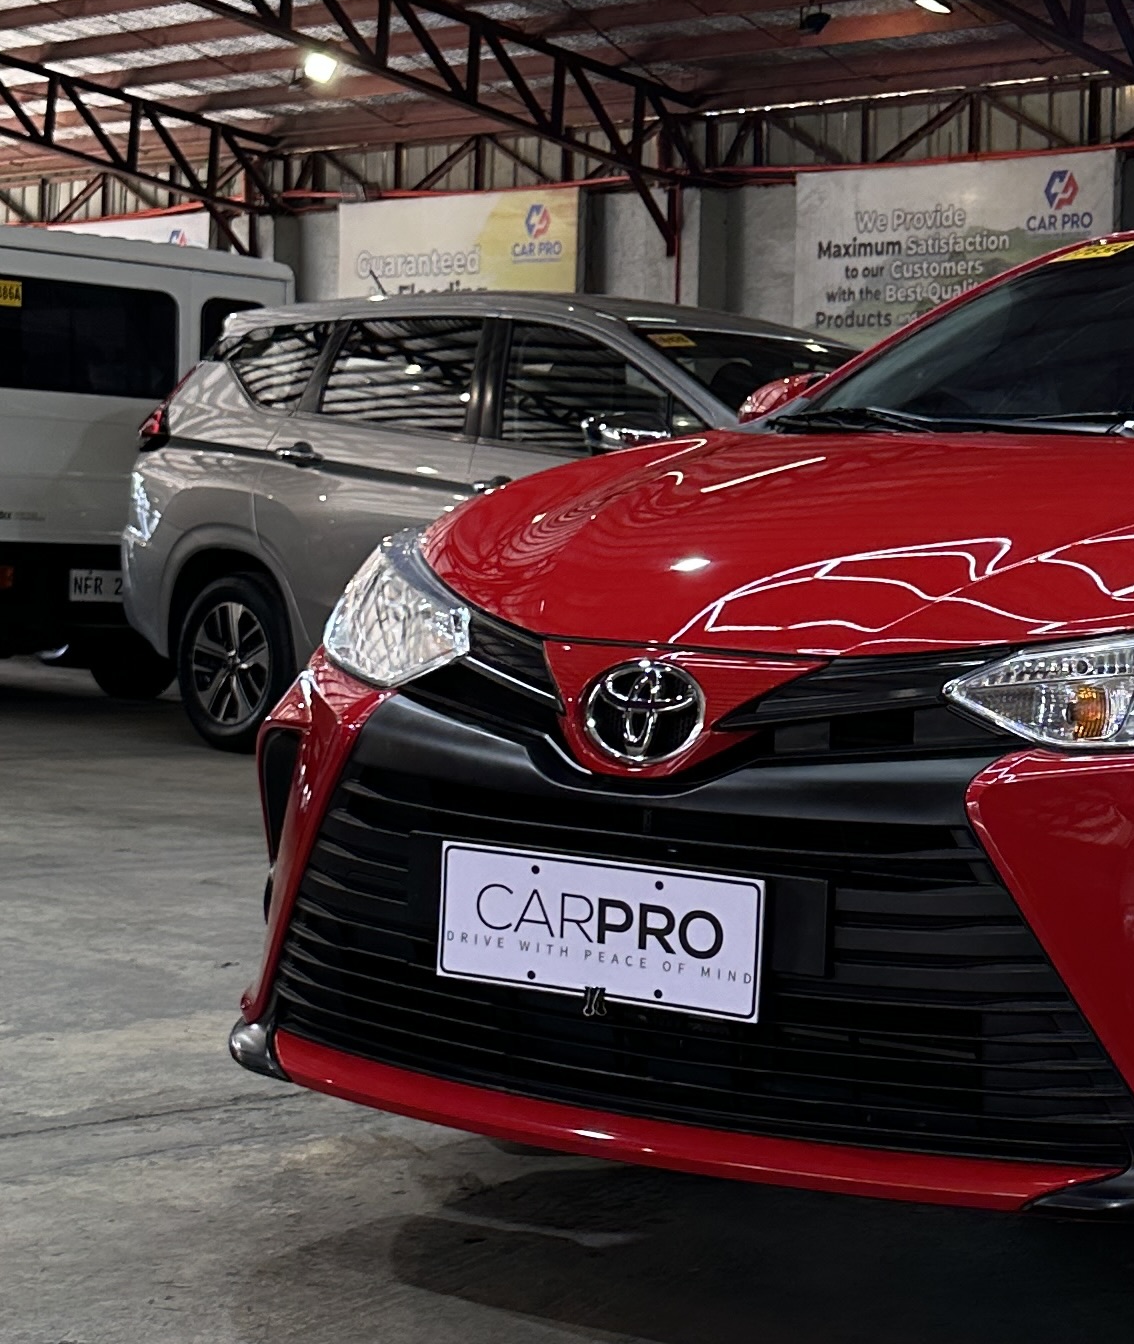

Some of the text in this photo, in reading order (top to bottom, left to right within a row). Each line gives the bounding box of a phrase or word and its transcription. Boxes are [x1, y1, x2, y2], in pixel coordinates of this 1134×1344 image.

[855, 203, 967, 233] We Provide
[1026, 212, 1093, 232] CAR PRO
[512, 240, 562, 257] CAR PRO
[818, 231, 1010, 259] Maximum Satisfaction
[357, 244, 482, 280] Guaranteed
[845, 259, 984, 279] to our Customers
[826, 278, 981, 304] with the Best Quali
[815, 311, 892, 329] Products
[74, 576, 103, 595] NFR
[476, 883, 724, 960] CARPRO
[447, 930, 752, 985] DRIVE WITH PEACE OF MIND
